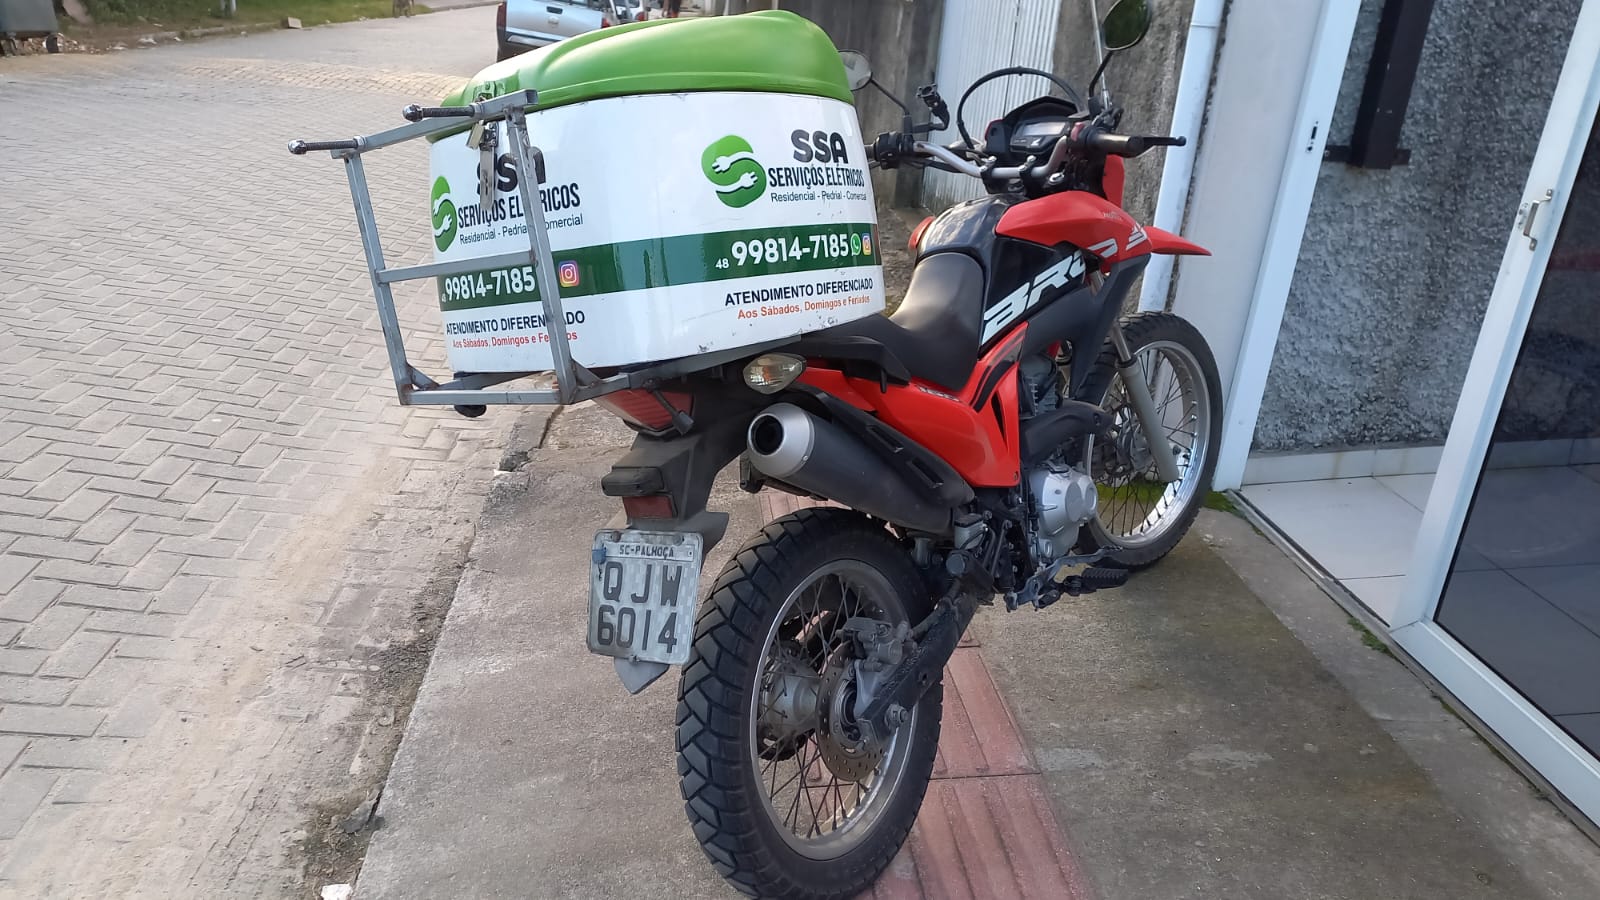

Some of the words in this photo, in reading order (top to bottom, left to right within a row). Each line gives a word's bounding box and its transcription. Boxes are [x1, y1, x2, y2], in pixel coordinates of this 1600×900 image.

[791, 129, 848, 164] SSA
[509, 183, 580, 219] ELRICOS
[771, 191, 815, 202] Residencial
[460, 229, 496, 245] Residencial
[503, 223, 527, 237] Pedria
[545, 213, 583, 230] omercial
[715, 258, 729, 270] 48
[731, 233, 849, 266] 99814-7185
[445, 266, 535, 301] 99814-7185
[725, 284, 813, 306] ATENDIMENTO
[817, 278, 873, 296] DIFERENCIADO
[446, 319, 498, 335] ATENDIMENTO
[501, 310, 585, 331] DIFERENDO
[737, 309, 757, 319] Aos
[804, 299, 841, 311] Domingos
[848, 295, 870, 305] Feriados
[492, 334, 529, 347] Domingos
[619, 544, 674, 560] SC-PALHOÇA
[603, 561, 682, 607] QJW
[597, 604, 678, 653] 6014
